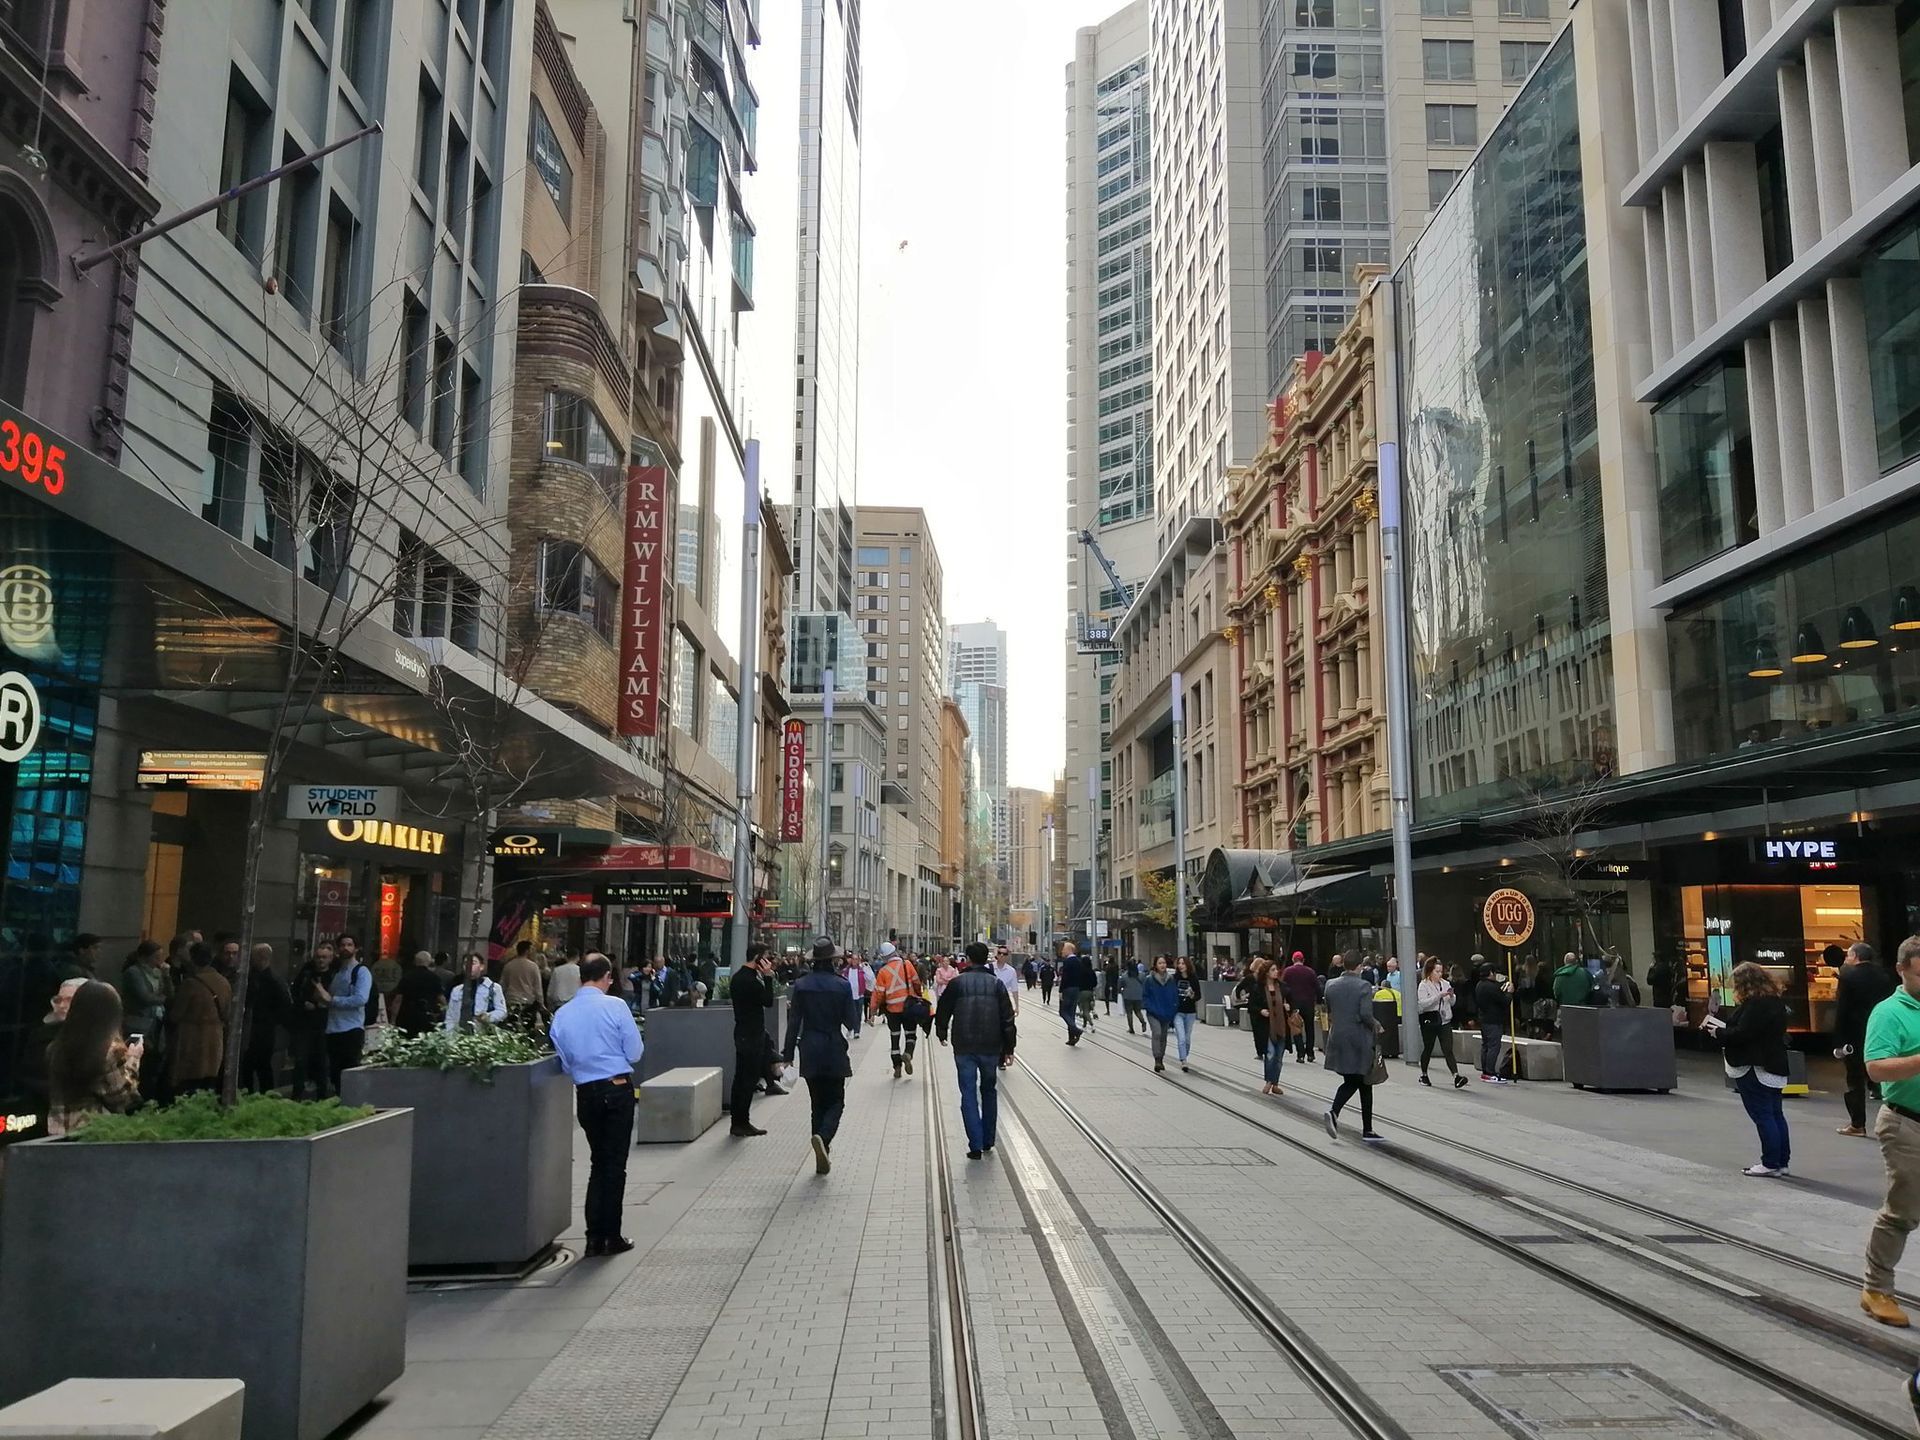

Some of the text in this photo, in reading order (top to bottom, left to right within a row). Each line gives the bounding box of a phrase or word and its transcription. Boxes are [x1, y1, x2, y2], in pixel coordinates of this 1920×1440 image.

[0, 419, 66, 495] 395
[1090, 630, 1107, 639] 388
[786, 732, 803, 837] McDonald's
[308, 788, 378, 801] STUDENT
[308, 800, 377, 816] WORLD
[495, 847, 545, 856] OAKLEY
[1766, 841, 1836, 858] HYPE
[1497, 903, 1522, 922] UGG
